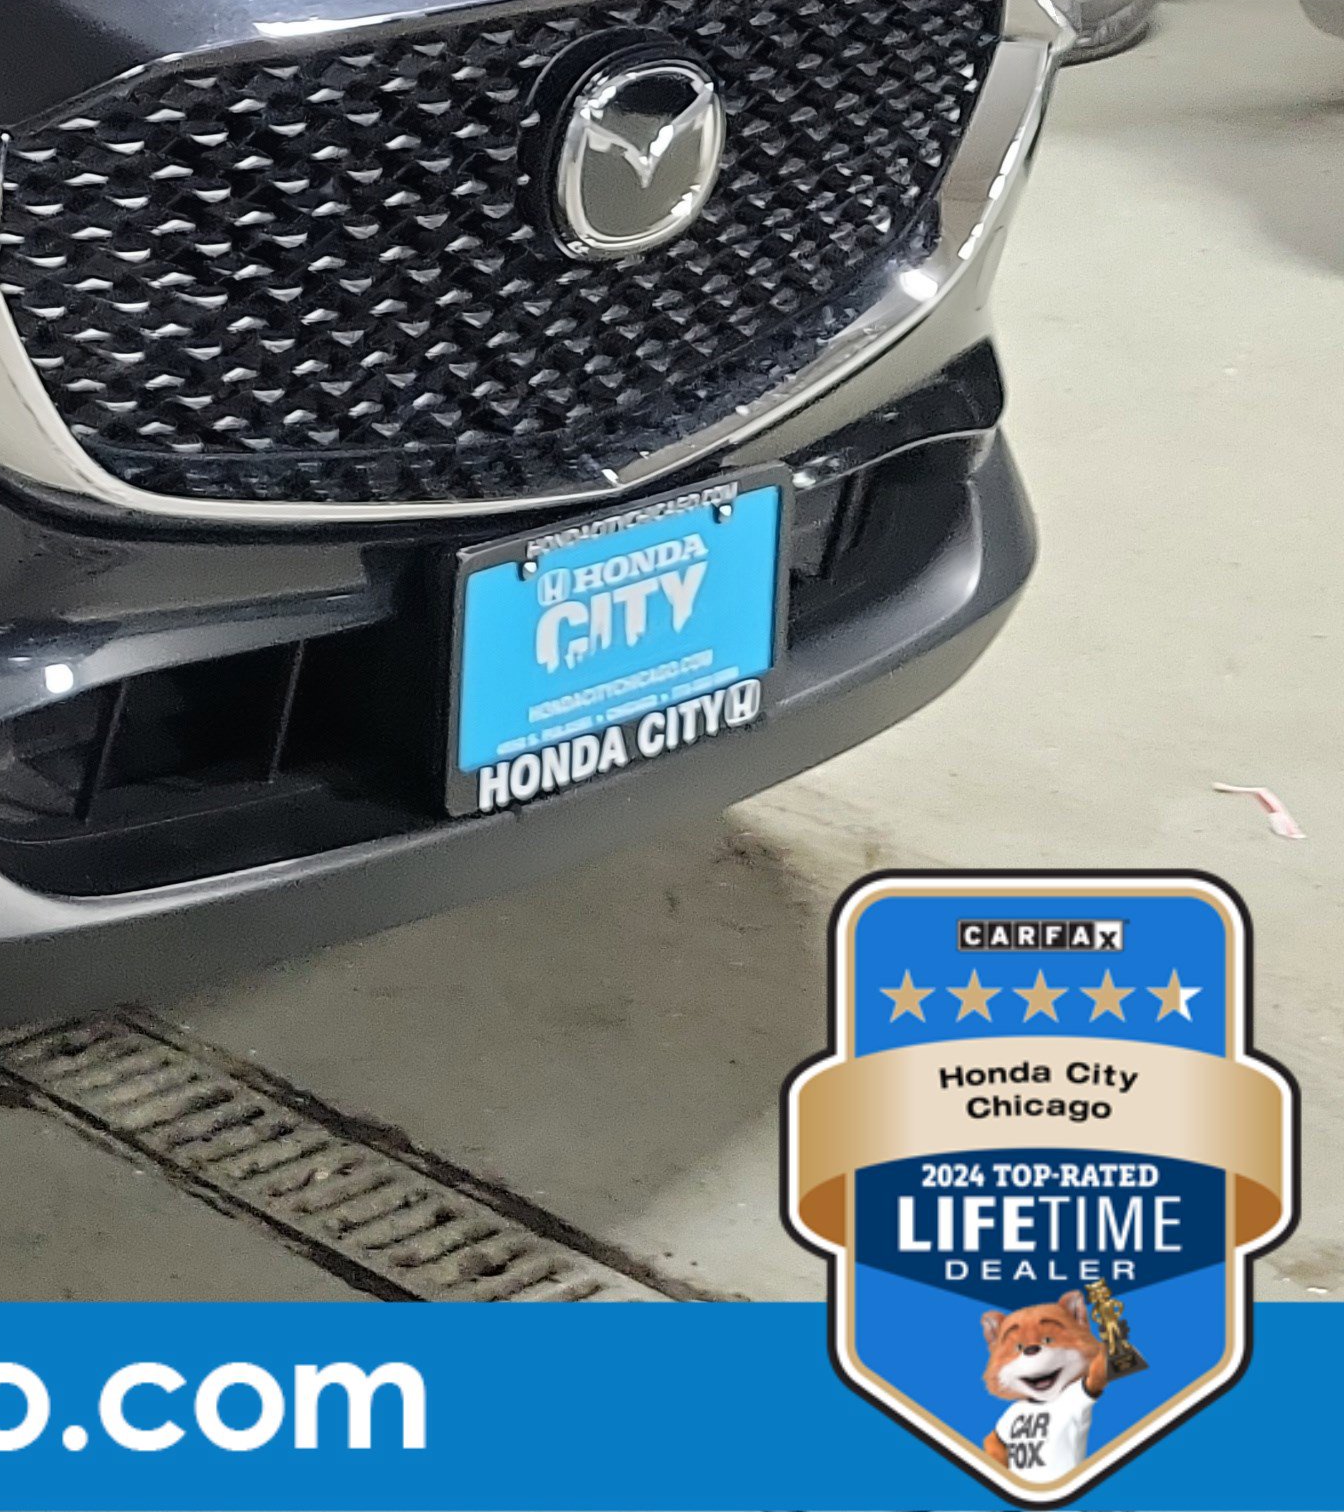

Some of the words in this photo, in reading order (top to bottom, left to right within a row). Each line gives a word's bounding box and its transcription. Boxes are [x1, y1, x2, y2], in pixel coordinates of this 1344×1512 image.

[534, 560, 710, 675] CITY
[572, 532, 710, 594] HONDA
[476, 724, 629, 814] HONDA
[636, 687, 726, 759] CITY
